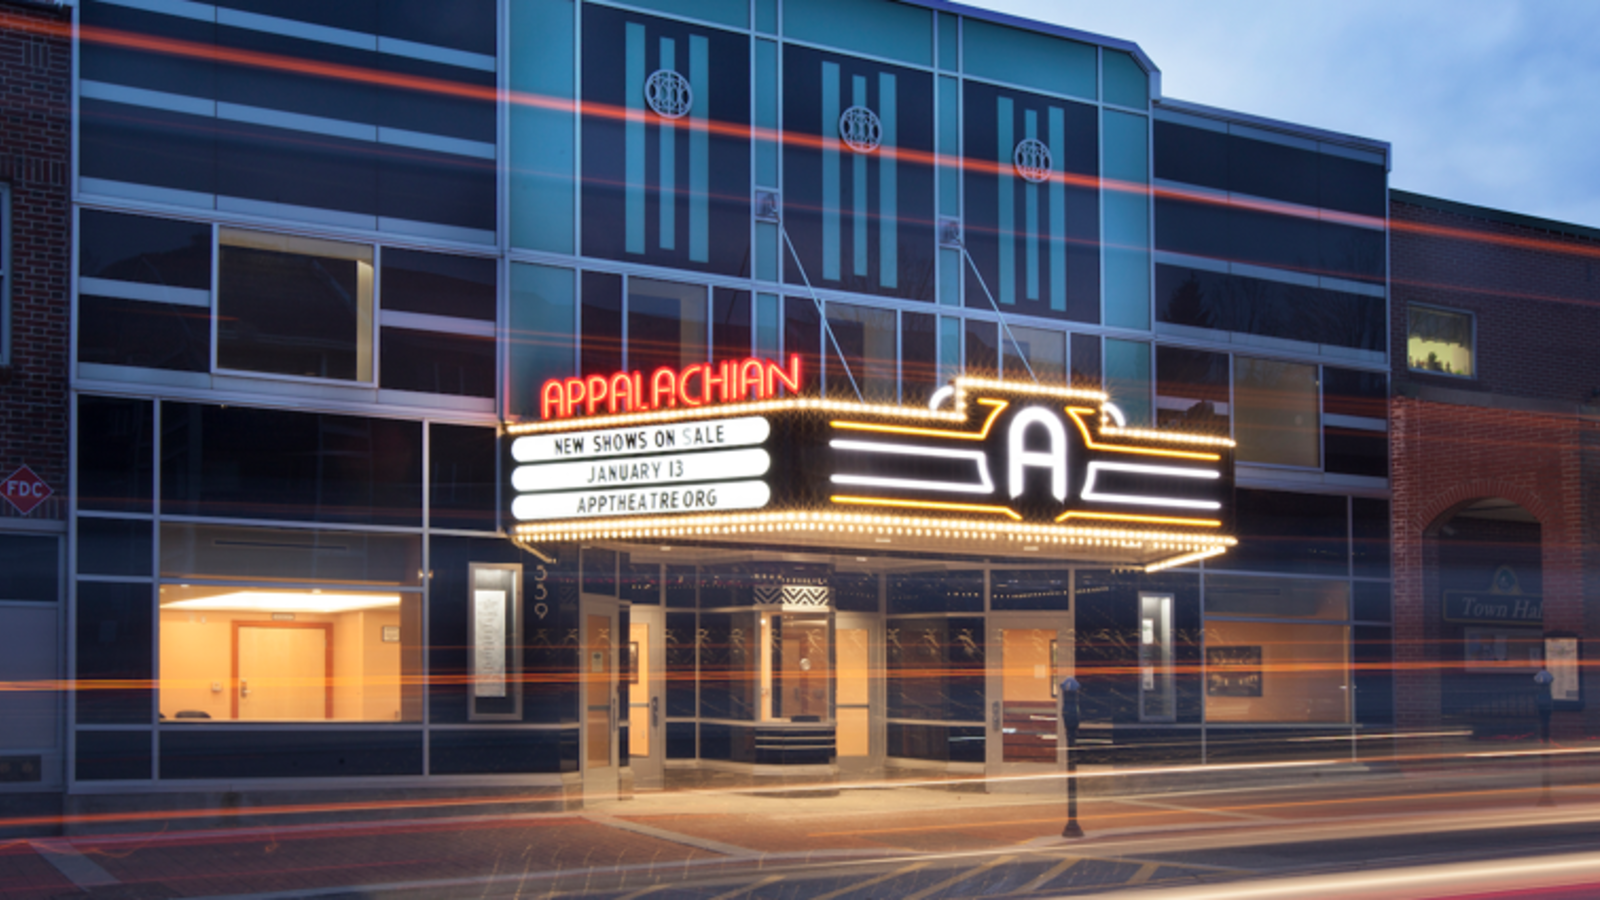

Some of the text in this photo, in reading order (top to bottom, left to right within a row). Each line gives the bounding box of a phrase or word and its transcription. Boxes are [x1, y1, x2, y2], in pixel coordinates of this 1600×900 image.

[540, 353, 802, 419] APPALACHIAN
[554, 425, 725, 455] NEW SHOWS ON SALE
[1008, 406, 1067, 503] A
[587, 459, 684, 483] JANUARY 13
[7, 481, 43, 498] FDC
[1462, 596, 1543, 619] Town Hal
